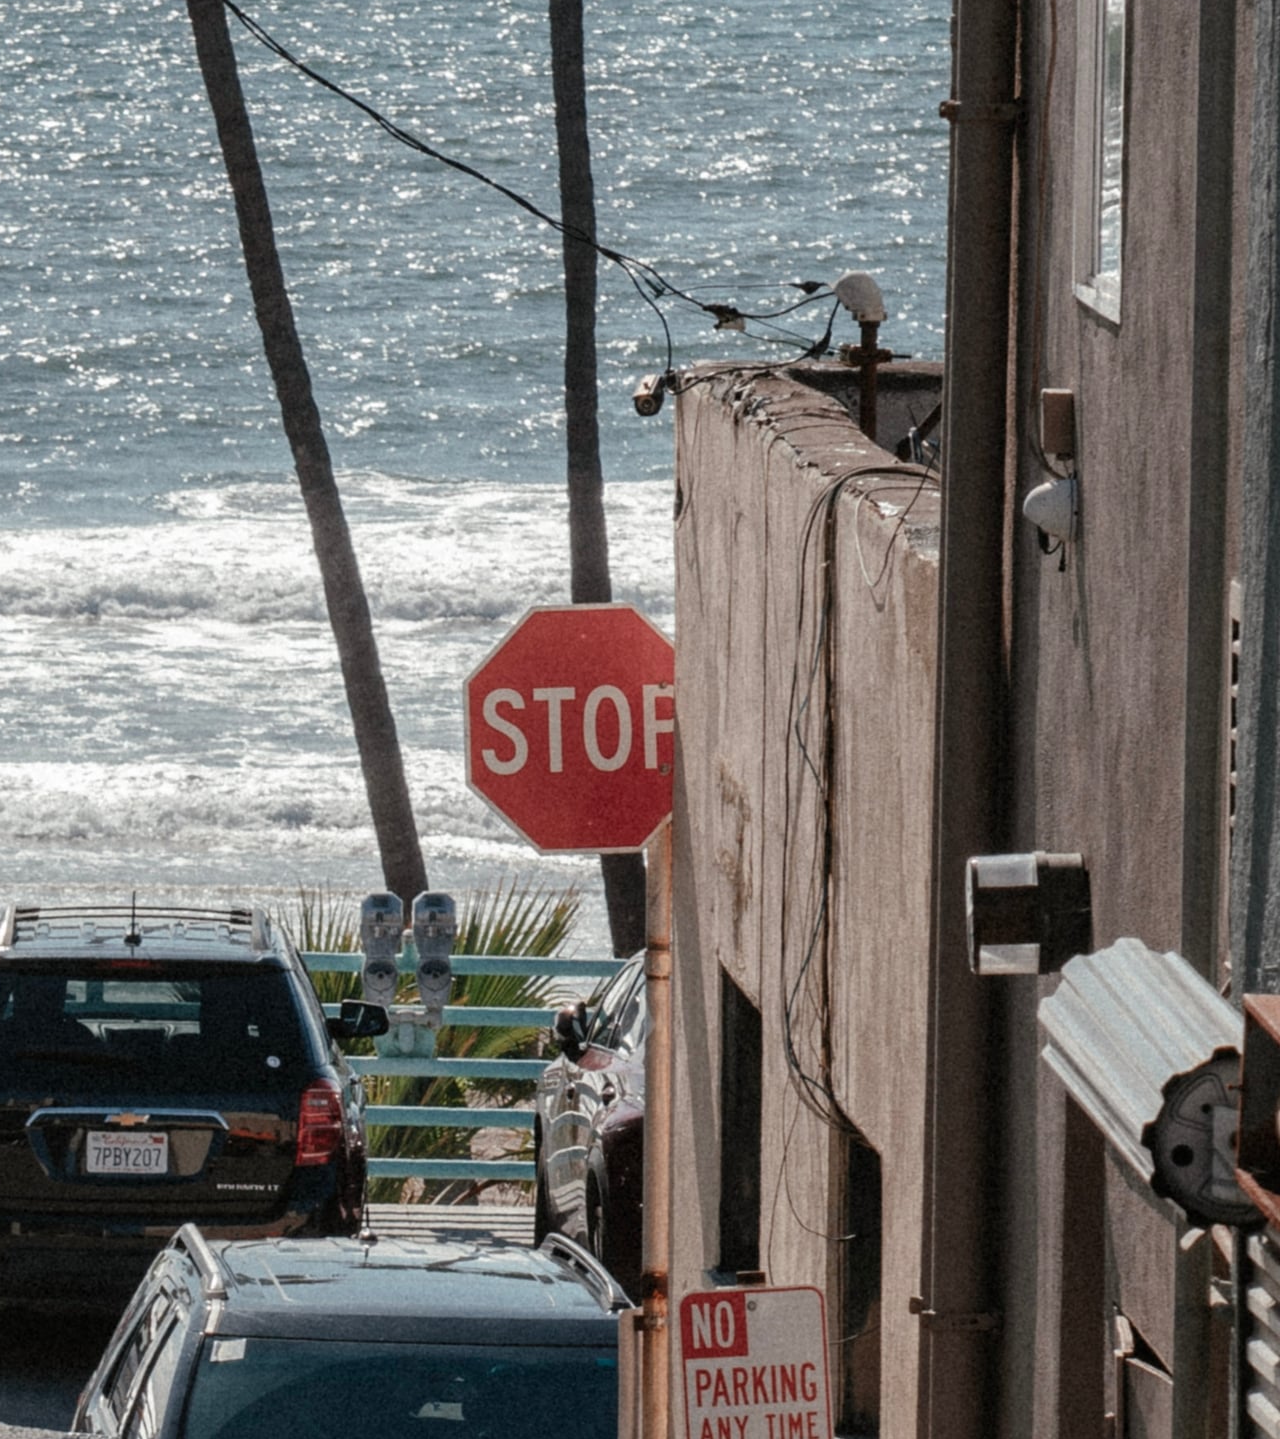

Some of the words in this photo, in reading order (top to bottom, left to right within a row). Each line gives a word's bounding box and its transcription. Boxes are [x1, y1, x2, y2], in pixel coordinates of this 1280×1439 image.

[481, 683, 676, 776] STOP
[93, 1147, 162, 1167] 7PBY207
[690, 1300, 736, 1349] NO
[695, 1361, 818, 1408] PARKING
